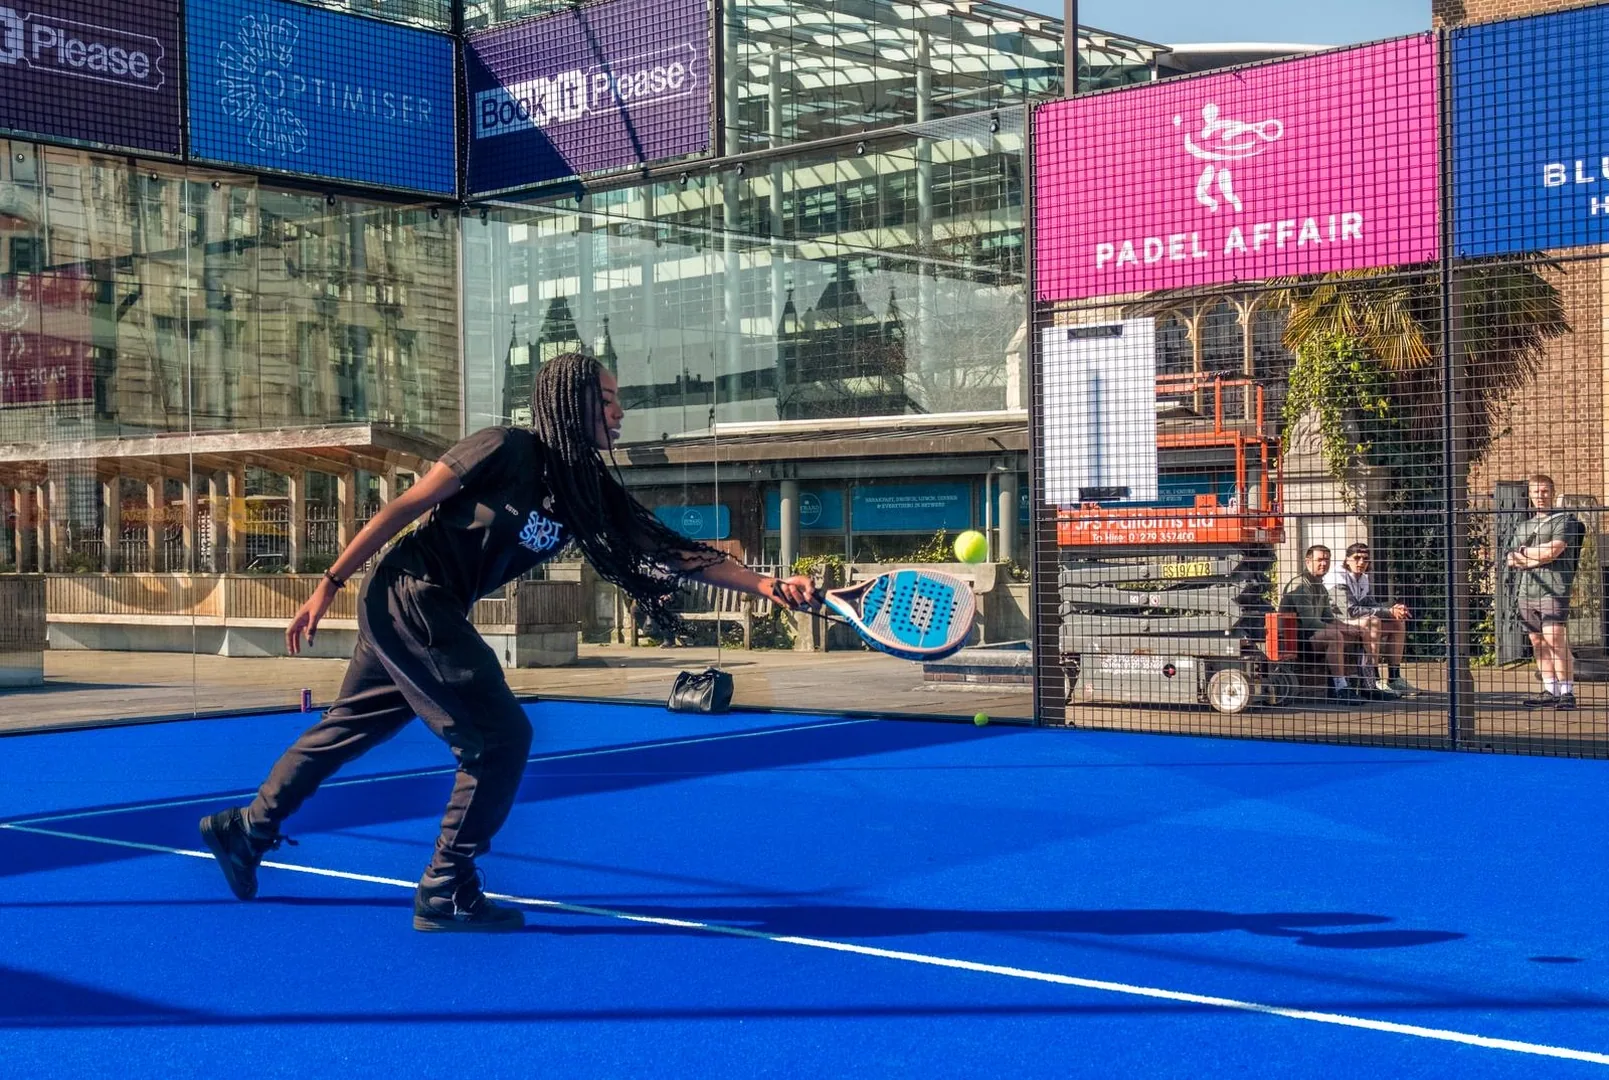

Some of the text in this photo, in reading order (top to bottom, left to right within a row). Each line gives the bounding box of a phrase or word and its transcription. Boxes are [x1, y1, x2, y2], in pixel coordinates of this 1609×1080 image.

[32, 23, 150, 79] Please
[262, 70, 433, 127] OPTIMISER
[481, 61, 685, 129] Book It Please
[1096, 211, 1364, 269] PADEL AFFAIR
[1075, 512, 1102, 530] JPS
[1188, 510, 1214, 529] Ltd
[1128, 532, 1157, 542] 0279
